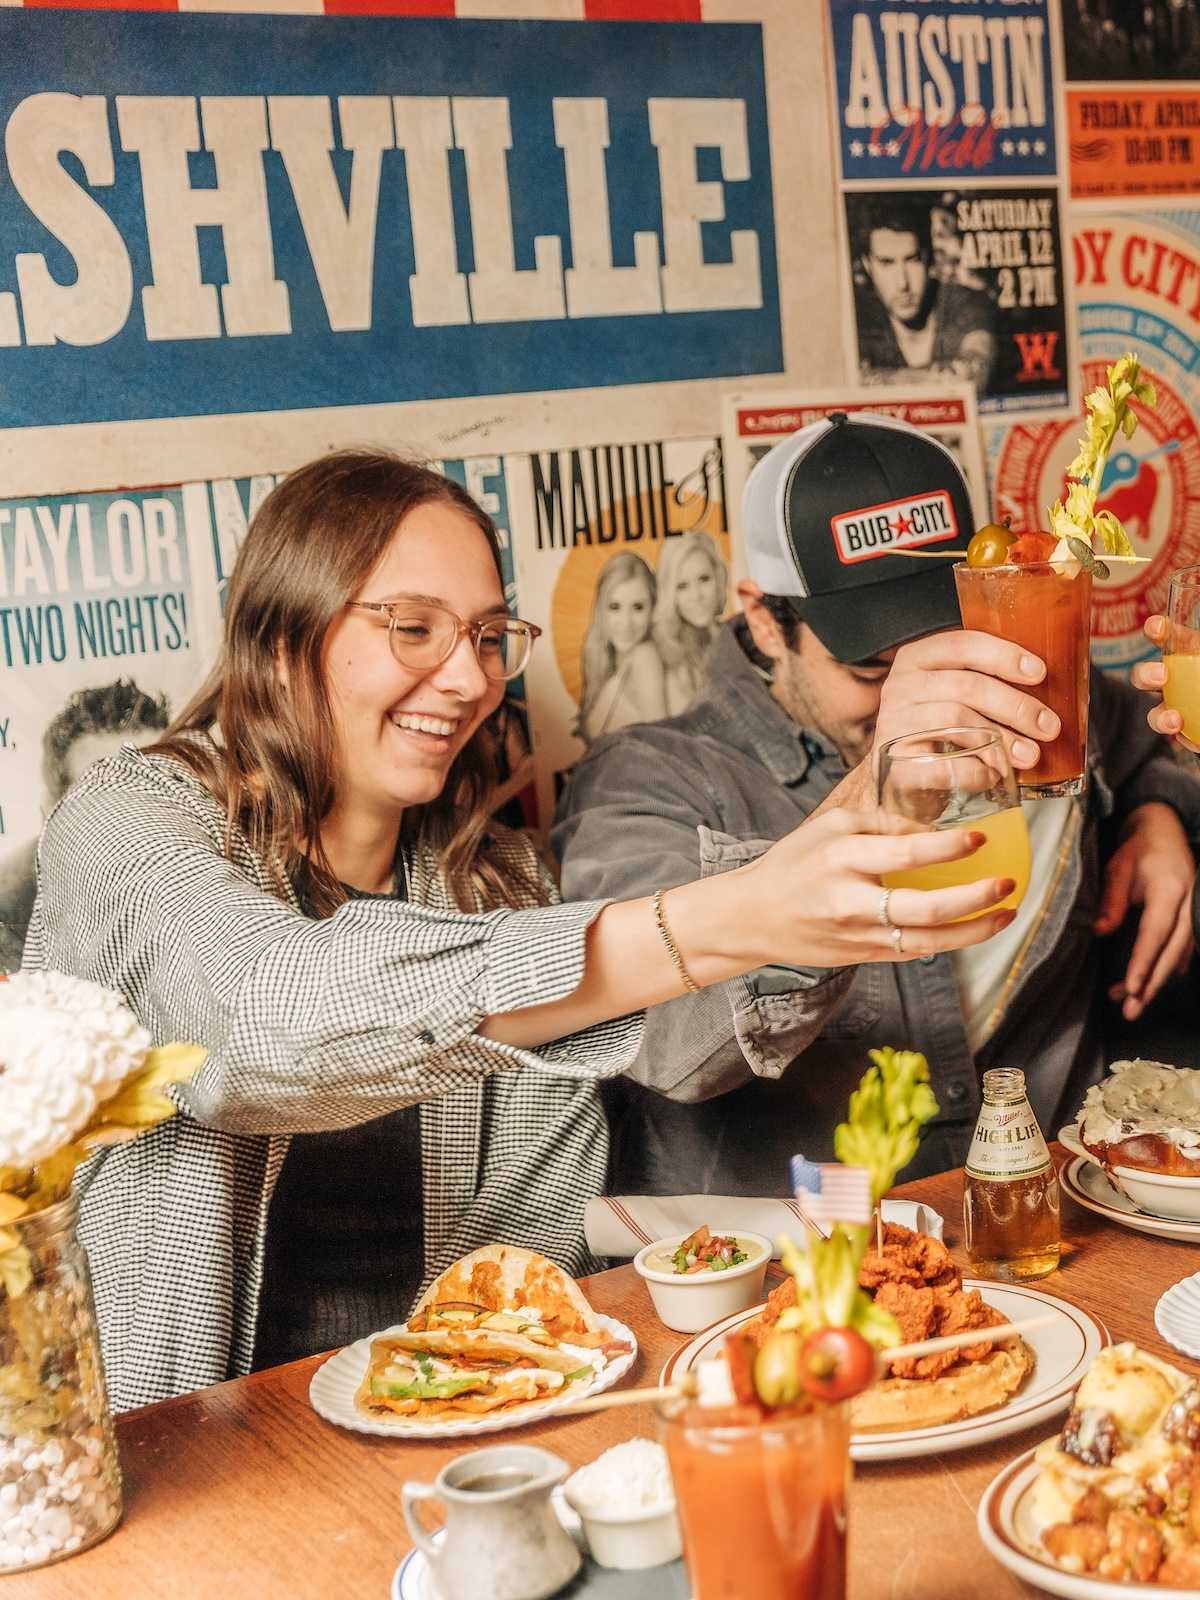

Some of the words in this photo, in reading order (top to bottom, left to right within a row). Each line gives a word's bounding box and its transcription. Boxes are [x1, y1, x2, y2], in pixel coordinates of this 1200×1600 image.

[846, 12, 1045, 128] AUSTIN
[0, 92, 763, 346] SHVILLE
[956, 199, 1053, 231] SATURDAY
[961, 230, 1027, 268] APRIL
[1028, 230, 1054, 266] 12
[998, 267, 1016, 308] 2
[1018, 266, 1057, 307] PM
[1013, 331, 1062, 381] W
[529, 441, 683, 549] MADDIE
[845, 515, 893, 551] BUB
[0, 604, 67, 667] TWO
[73, 592, 190, 660] NIGHTS!
[976, 1124, 1013, 1144] HIGH
